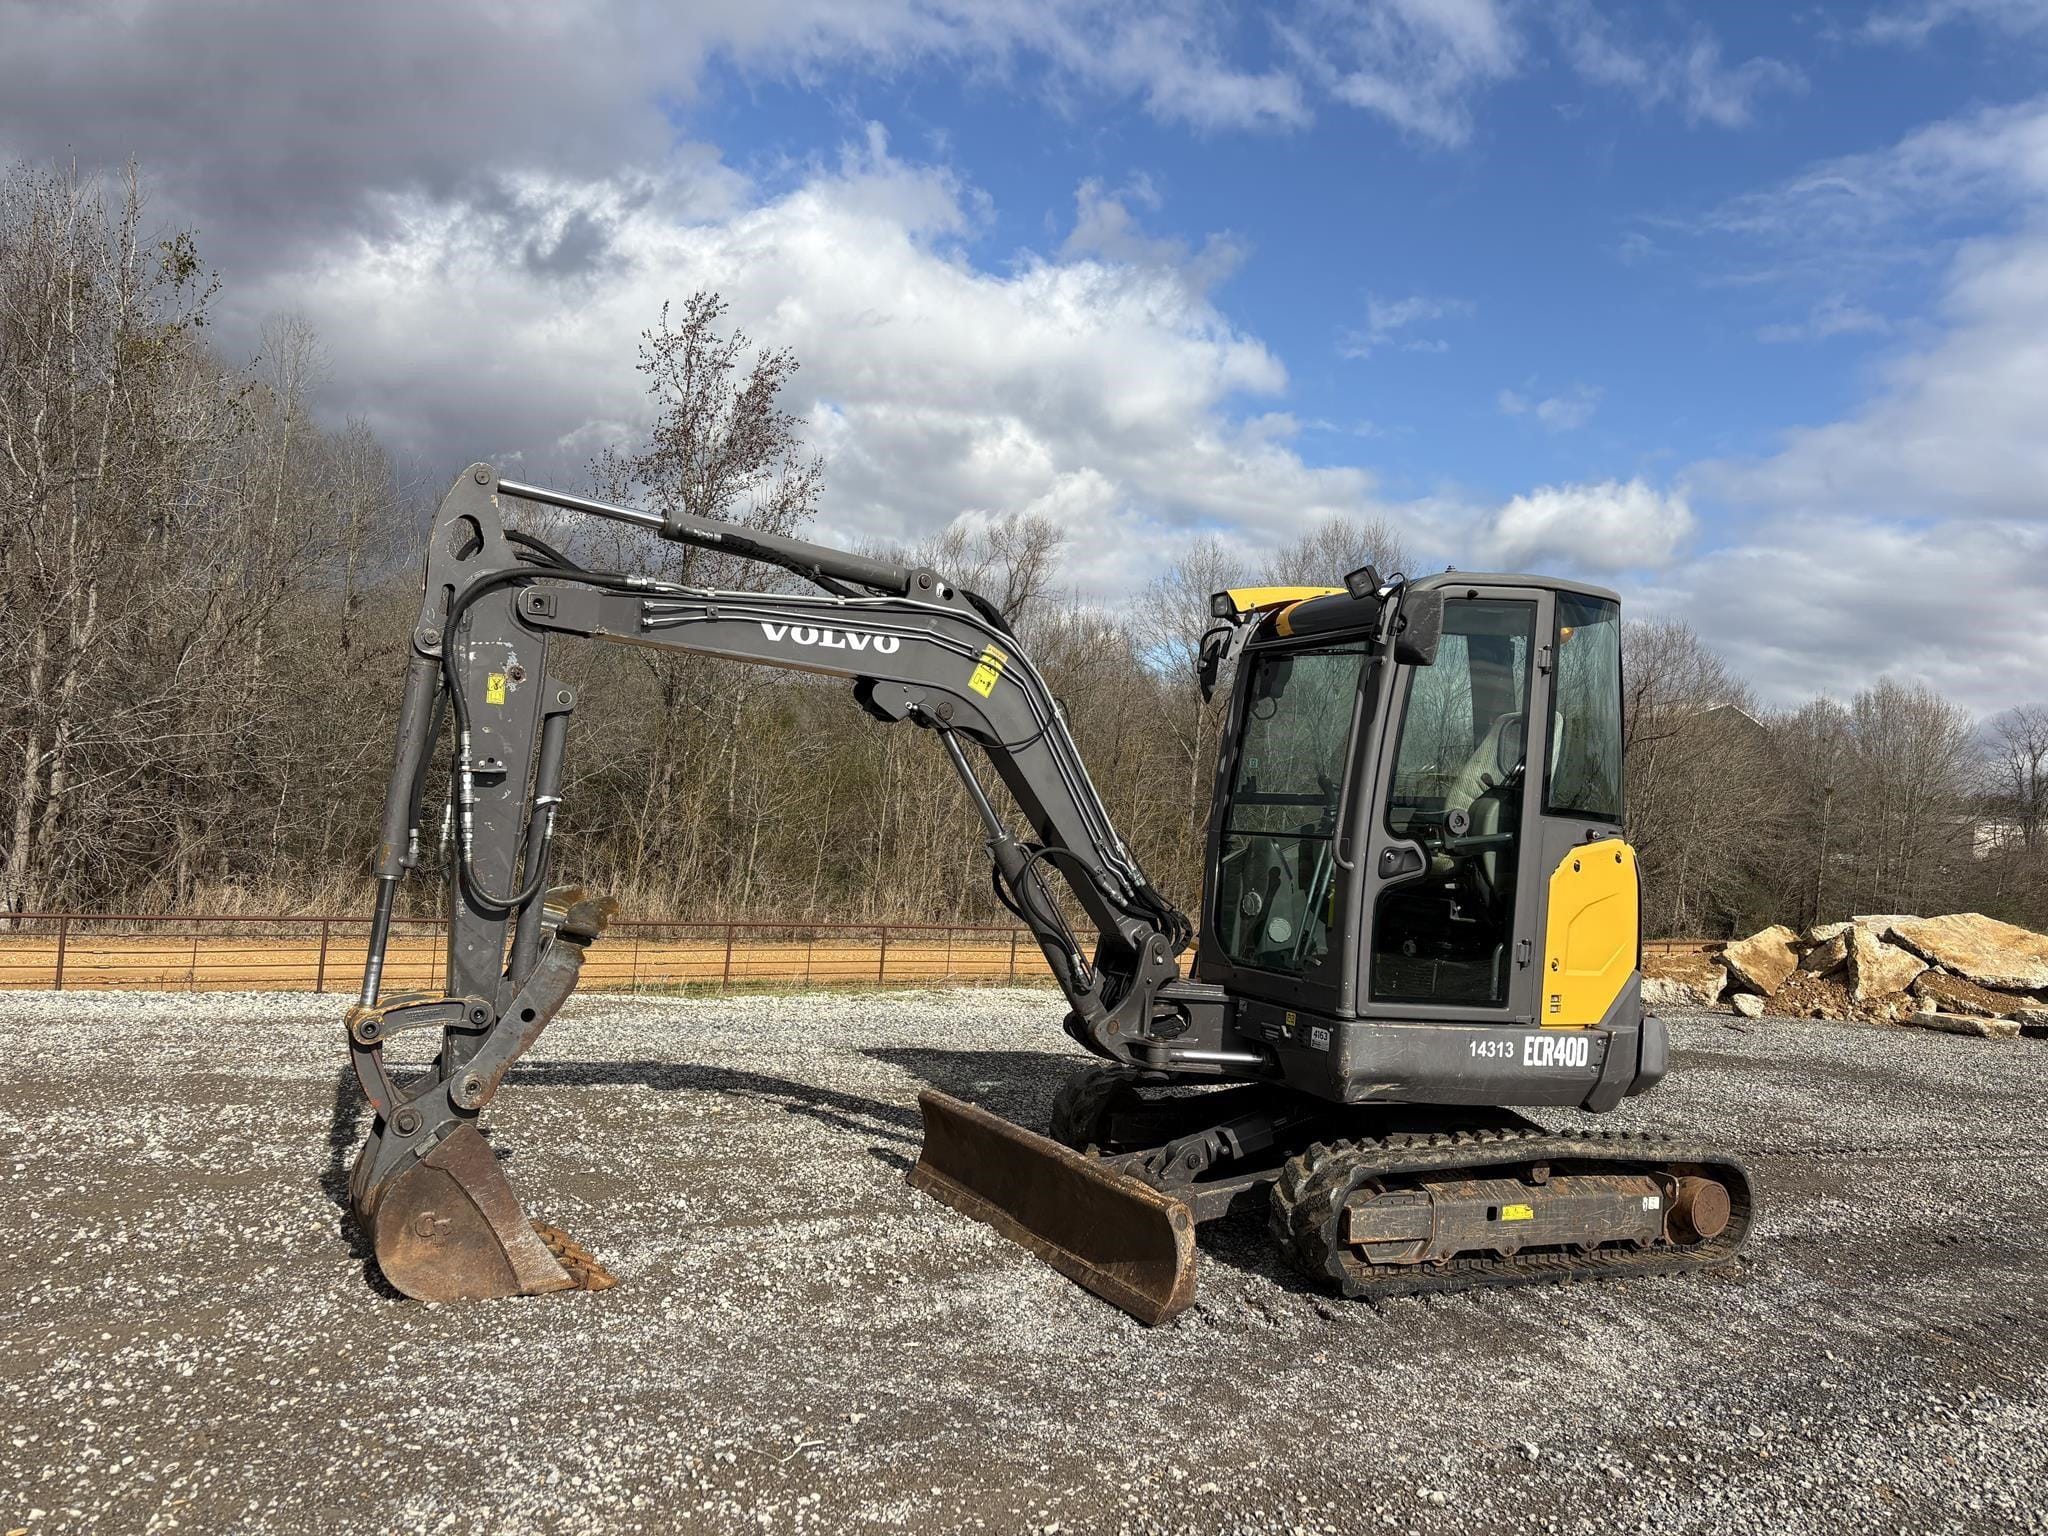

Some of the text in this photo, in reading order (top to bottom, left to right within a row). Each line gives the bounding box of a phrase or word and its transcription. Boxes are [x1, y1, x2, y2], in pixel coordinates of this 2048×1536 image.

[761, 622, 900, 654] VOLVO
[1313, 1030, 1328, 1040] 4163
[1469, 1036, 1589, 1067] 14313 ECR40D
